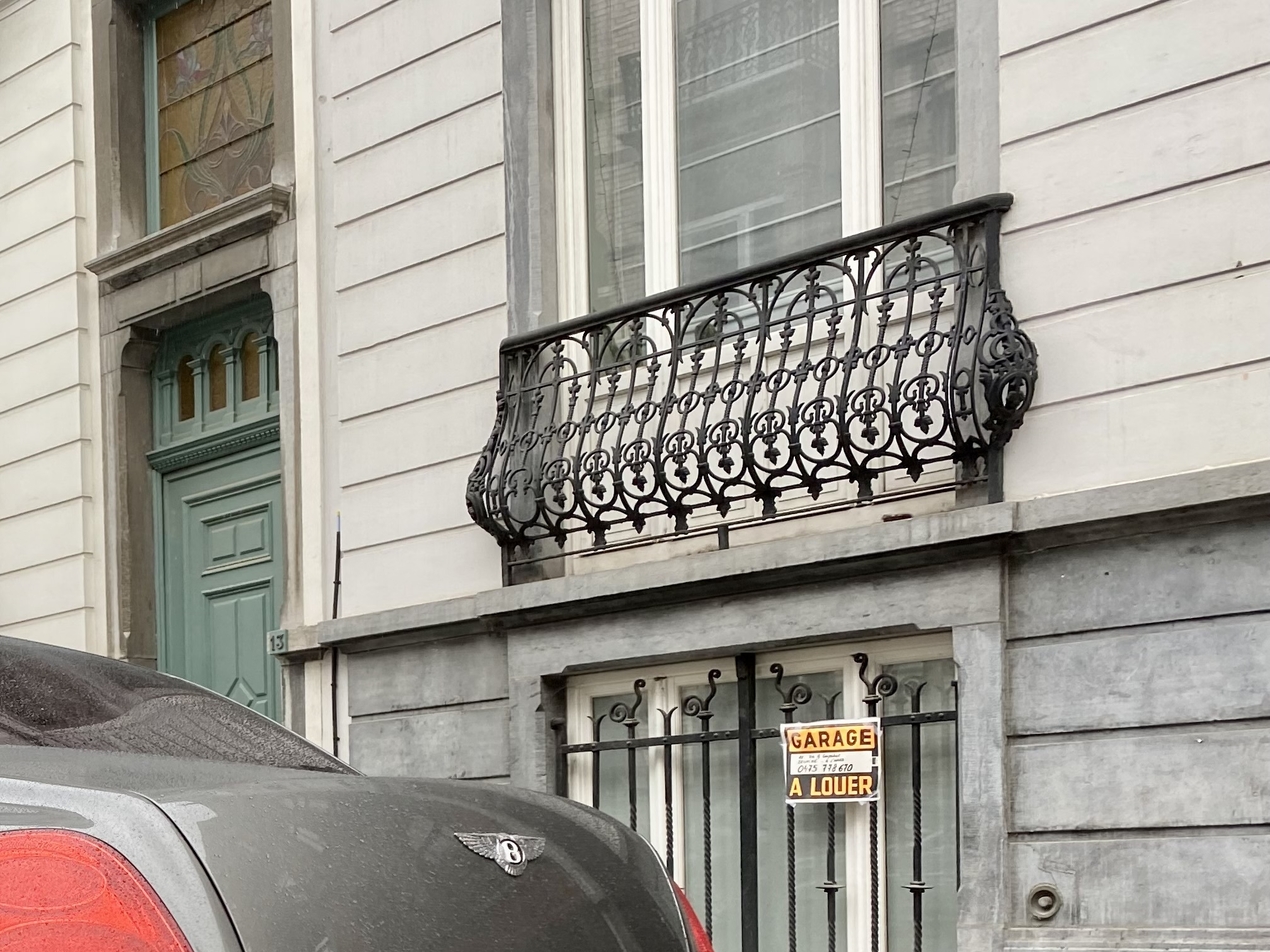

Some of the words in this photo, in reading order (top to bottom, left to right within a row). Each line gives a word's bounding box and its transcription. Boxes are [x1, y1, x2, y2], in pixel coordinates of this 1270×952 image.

[270, 633, 285, 652] 13
[791, 729, 872, 749] GARAGE
[789, 777, 803, 797] A
[810, 775, 873, 797] LOUER
